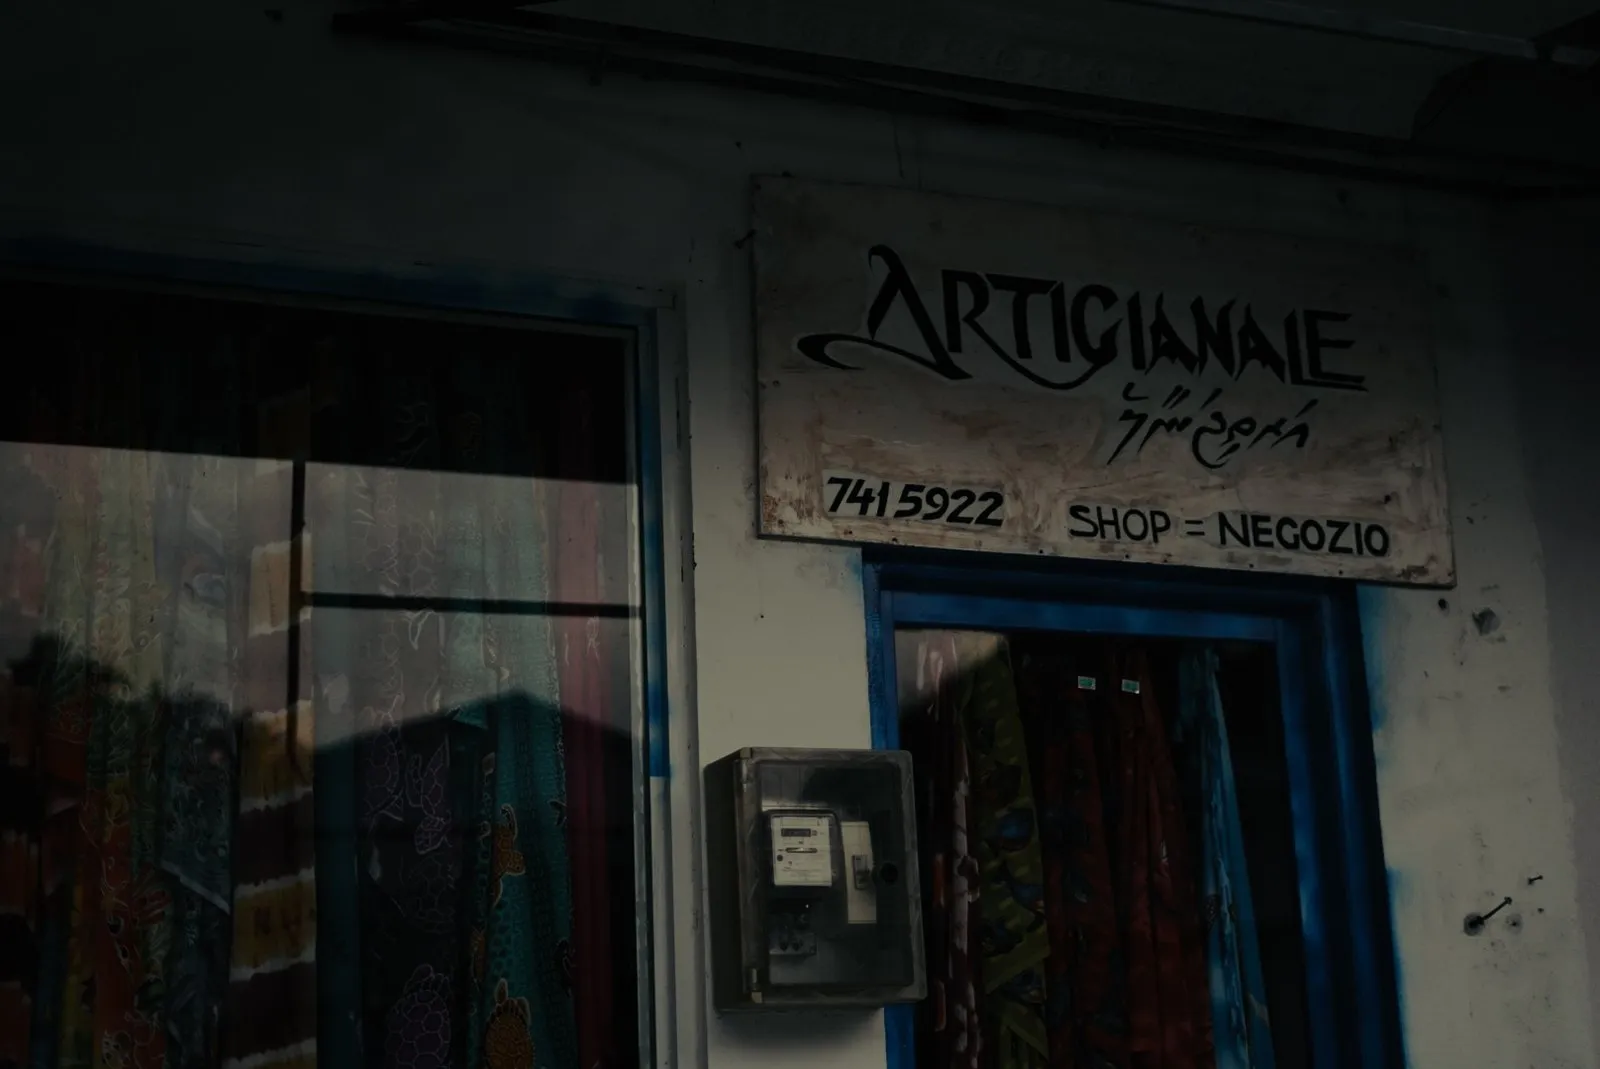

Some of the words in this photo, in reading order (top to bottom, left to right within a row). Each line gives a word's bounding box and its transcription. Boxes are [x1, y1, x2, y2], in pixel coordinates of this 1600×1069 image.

[797, 244, 1369, 392] ARTIGIANALE
[1069, 504, 1171, 543] SHOP
[1218, 511, 1390, 557] NEGOZIO
